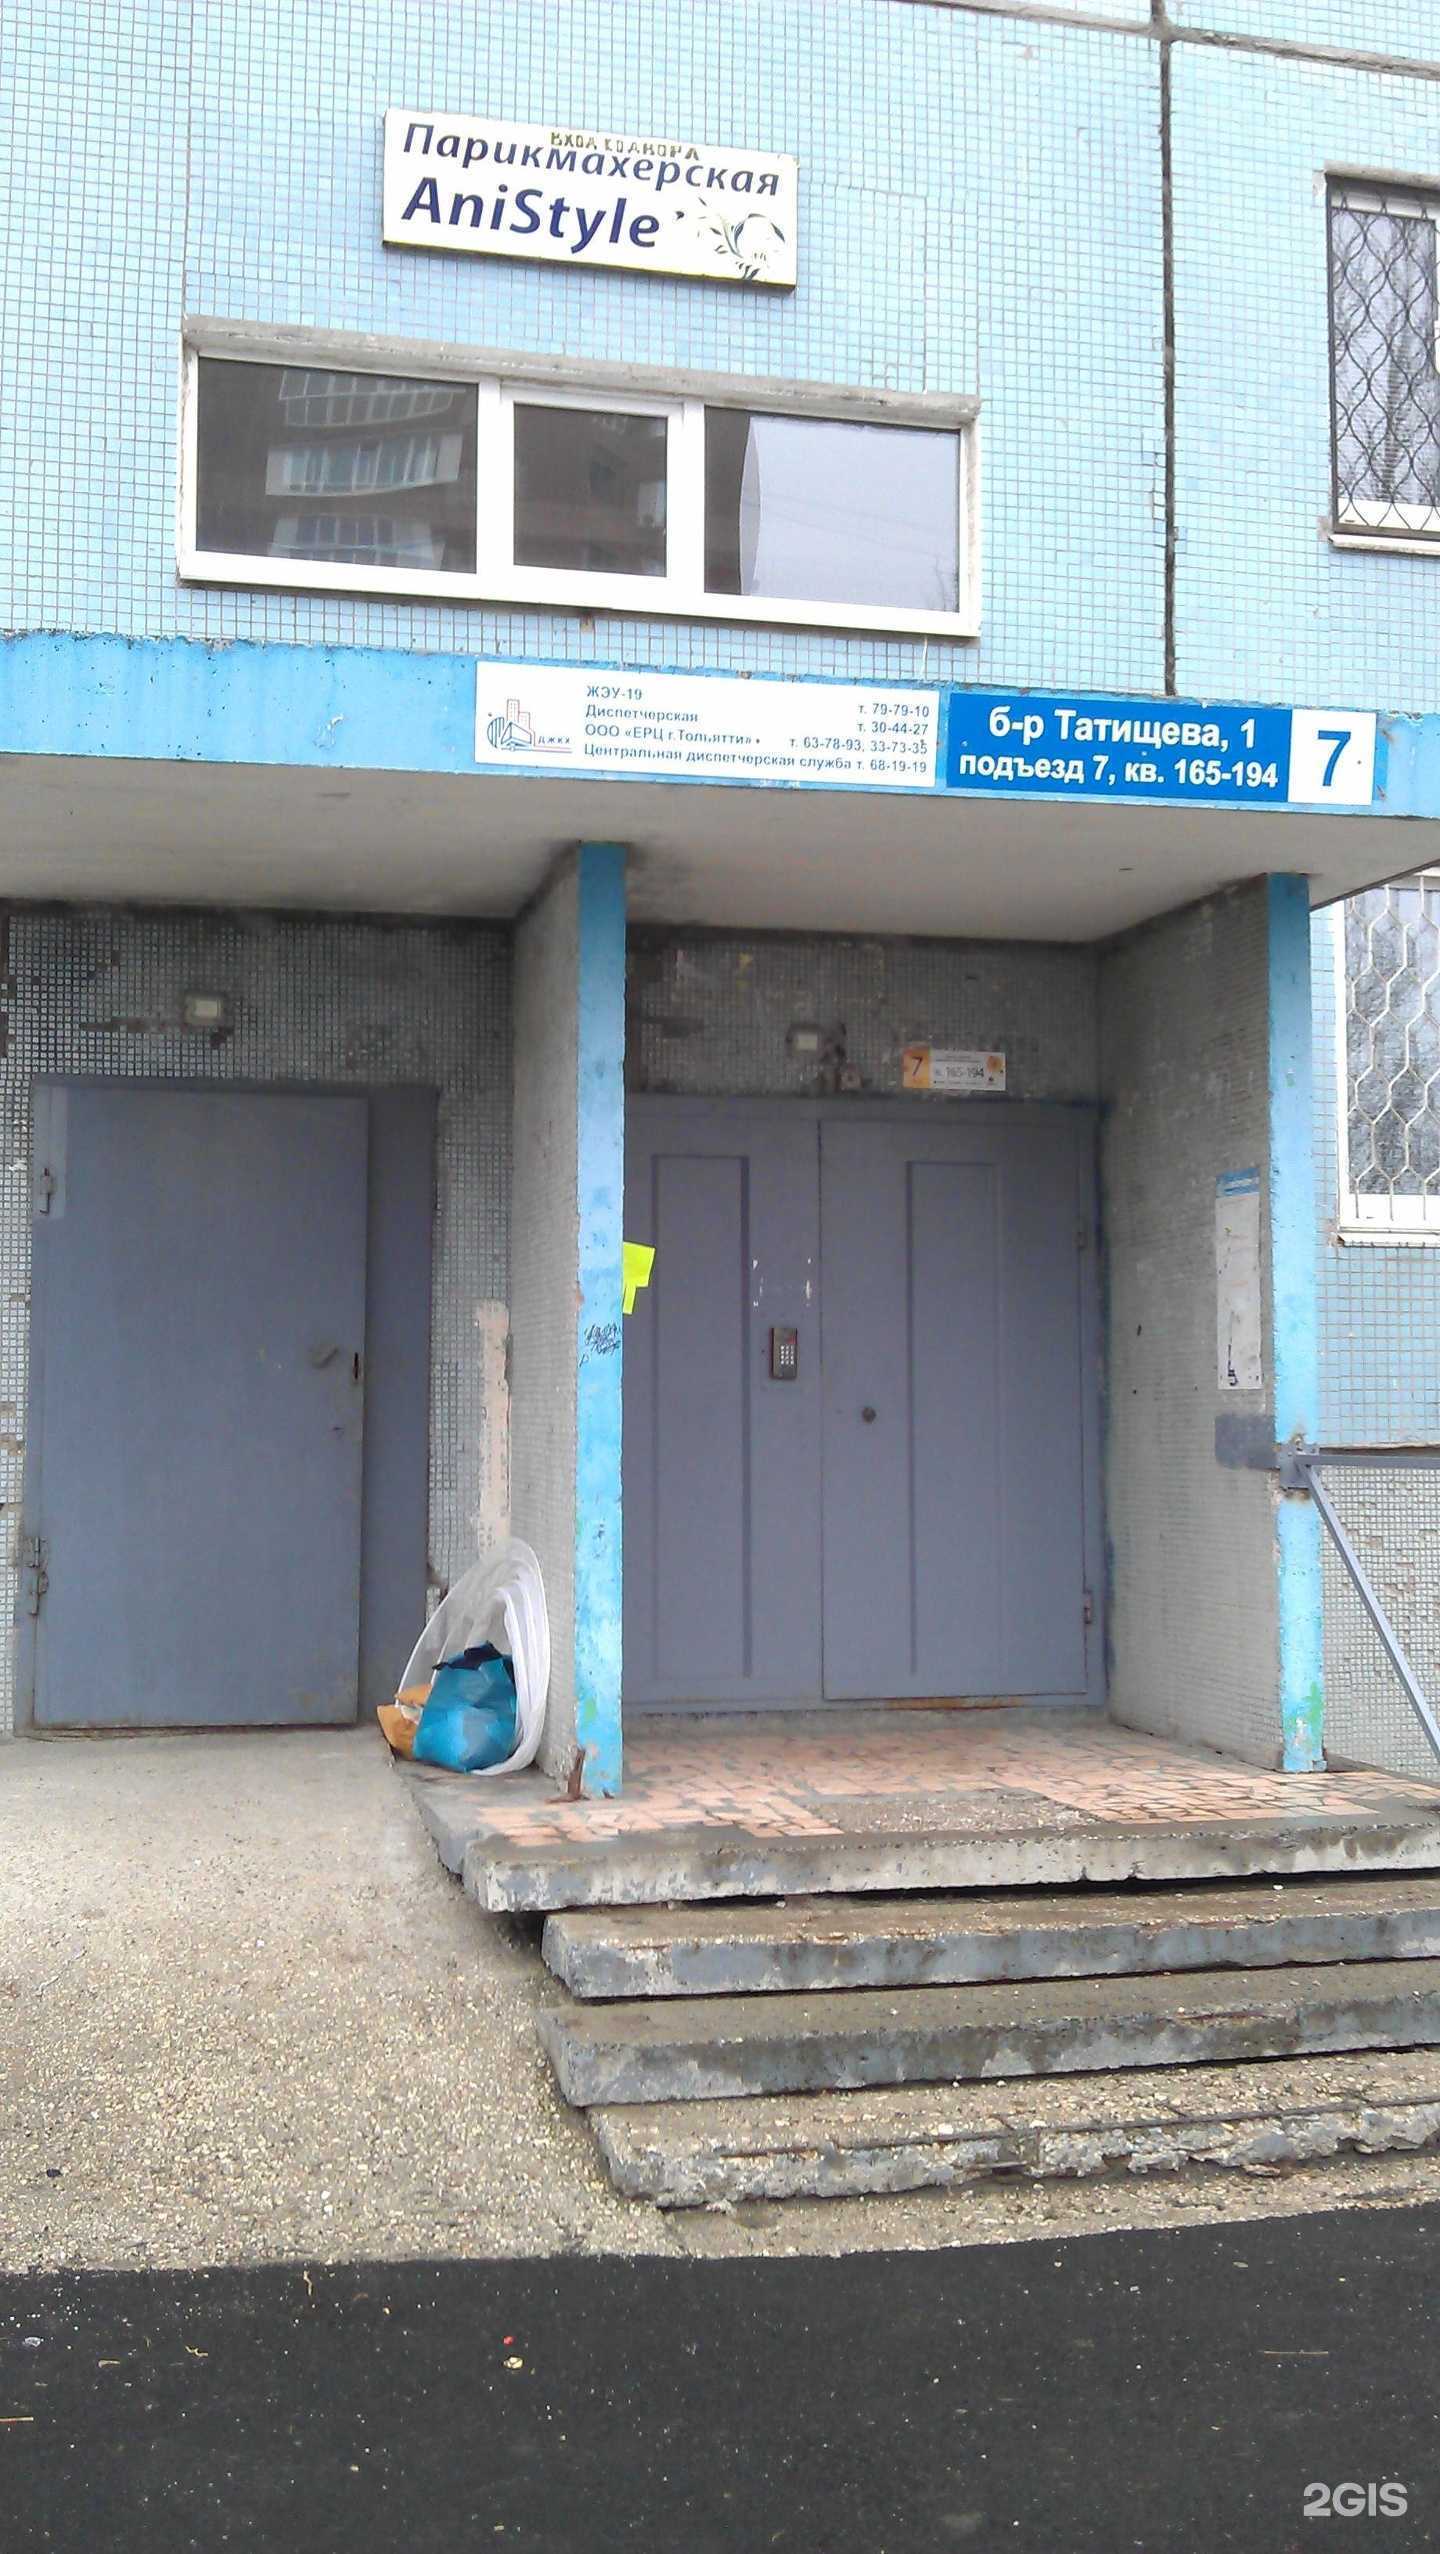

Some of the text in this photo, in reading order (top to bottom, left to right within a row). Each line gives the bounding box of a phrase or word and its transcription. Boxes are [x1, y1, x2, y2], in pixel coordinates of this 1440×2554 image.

[403, 123, 780, 196] Парикмахерская
[401, 176, 661, 254] AniStyle
[586, 685, 643, 701] ЖЭУ-19
[585, 704, 699, 723] Диспетчерская
[872, 702, 930, 718] 79-79-10
[585, 724, 621, 737] ООО
[625, 726, 665, 742] «ЕРЦ
[871, 720, 929, 736] 30-44-27
[989, 706, 1255, 753] б-р Татищева, 1
[584, 743, 682, 760] Центральная
[686, 750, 796, 769] диспетчерская
[799, 757, 852, 772] служба
[870, 758, 928, 774] 68-19-19
[870, 739, 929, 755] 33-73-35
[1317, 730, 1351, 788] 7
[959, 753, 1278, 788] подъезд 7, кв. 165-194
